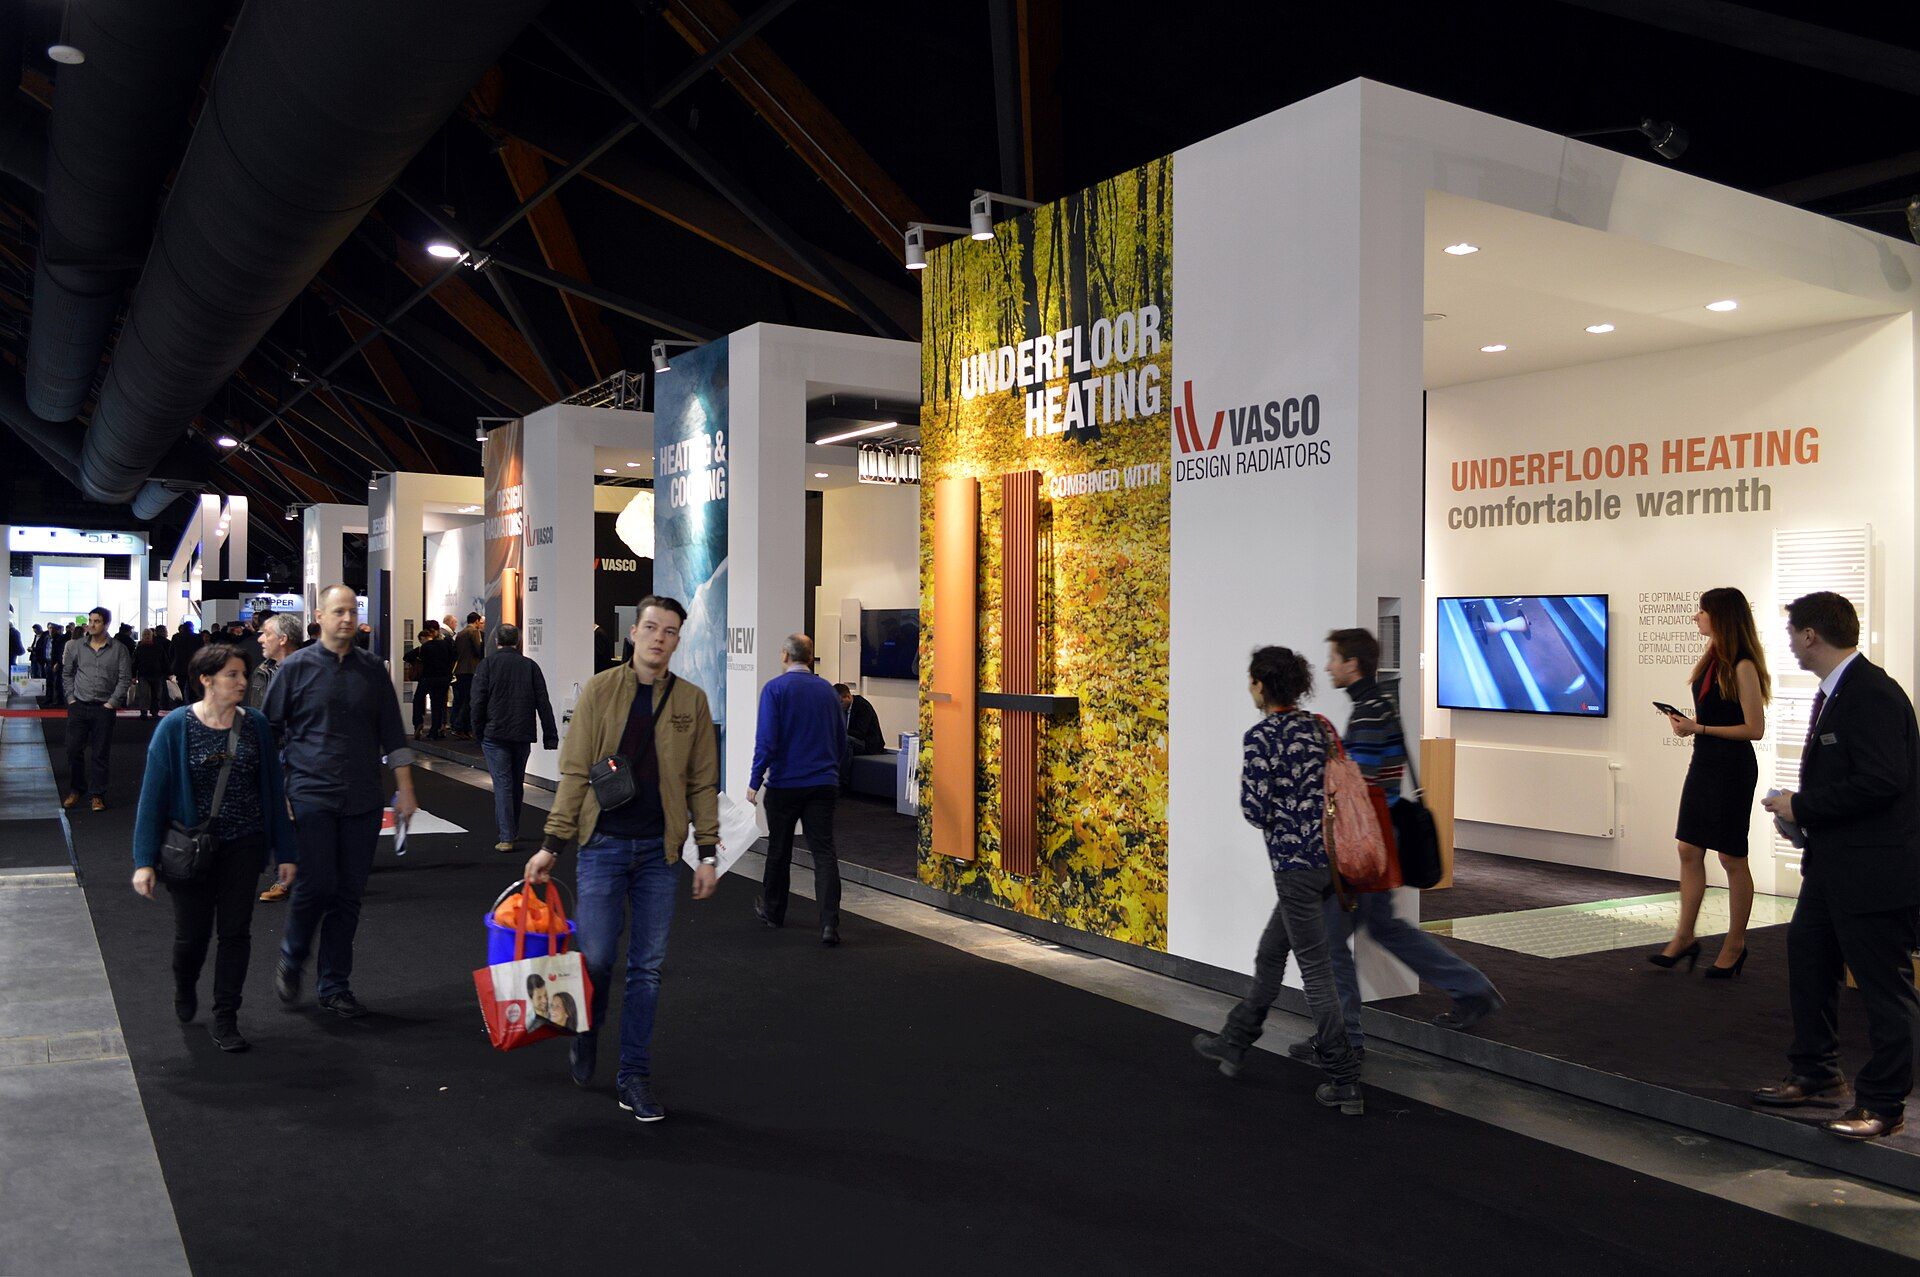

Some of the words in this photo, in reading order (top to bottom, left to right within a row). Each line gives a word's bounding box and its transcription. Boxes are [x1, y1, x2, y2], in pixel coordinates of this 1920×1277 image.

[961, 305, 1160, 400] UNDERFLOOR
[1025, 364, 1160, 438] HEATING
[1229, 394, 1320, 446] VASCO
[660, 434, 711, 477] HEATG
[715, 430, 726, 463] &
[1176, 453, 1231, 482] DESIGN
[1236, 440, 1331, 474] RADIATORS
[1451, 442, 1649, 492] UNDERFLOOR
[1662, 427, 1819, 474] HEATING
[1050, 468, 1119, 499] COMBINED
[1124, 462, 1161, 488] WITH
[1448, 489, 1621, 530] comfortable
[1636, 477, 1771, 518] warmth
[601, 558, 637, 572] VASCO
[1639, 592, 1649, 603] DE
[1651, 591, 1690, 603] OPTIMALE
[1639, 603, 1692, 614] VERWARMING
[1639, 615, 1655, 626] MET
[528, 626, 543, 646] NEW
[727, 627, 755, 654] NEW
[1638, 631, 1648, 642] LE
[1638, 643, 1672, 653] OPTIMAL
[1674, 643, 1686, 653] EN
[1638, 654, 1654, 665] DES
